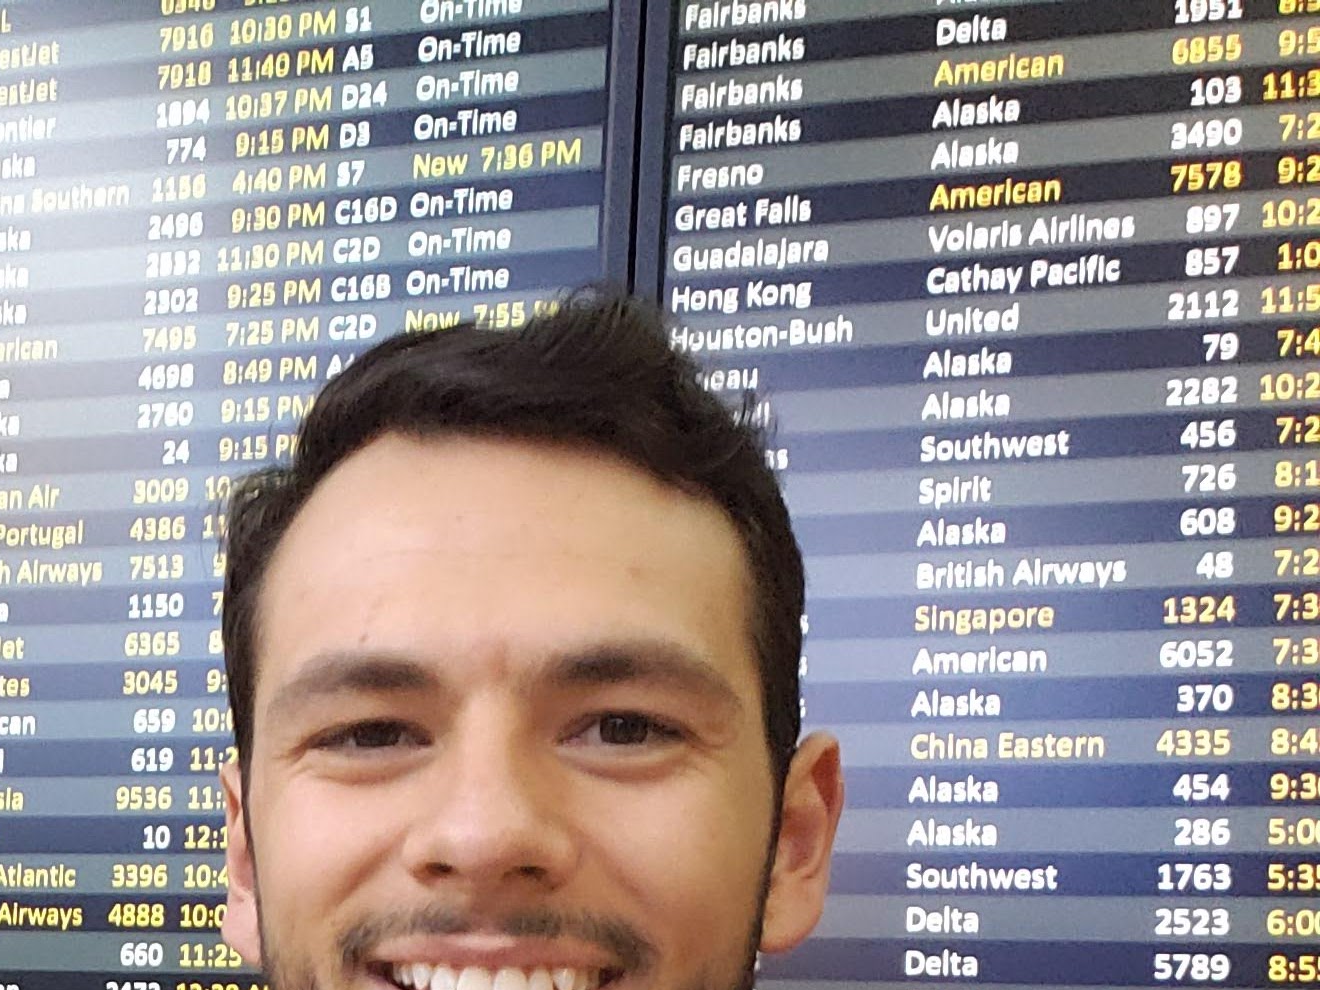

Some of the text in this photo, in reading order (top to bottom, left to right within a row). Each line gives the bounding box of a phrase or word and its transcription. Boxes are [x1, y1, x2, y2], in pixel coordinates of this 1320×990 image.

[297, 48, 335, 76] PM
[418, 31, 522, 63] On-Time
[683, 0, 1244, 71] Fairbanks Delta 1951
[681, 34, 1242, 111] Fairbanks American 6855
[679, 76, 1242, 152] Fairbanks Alaska 103
[289, 163, 327, 191] PM
[414, 154, 468, 179] Now
[541, 138, 582, 168] PM
[677, 119, 1243, 192] Fresno Alaska 3490
[674, 161, 1242, 232] Great Falls American 7578
[672, 204, 1240, 272] Guadalajara Volaris Airlines 897
[671, 246, 1240, 314] Hong Kong Cathay Pacific 857
[670, 290, 1239, 353] Houston-Bush United 2112
[920, 420, 1237, 463] Southwest 456
[918, 464, 1237, 510] Spirit 726
[130, 516, 186, 542] 4386
[916, 552, 1234, 590] British Airways 48
[914, 596, 1236, 636] Singapore 1324
[125, 632, 180, 657] 6365
[912, 640, 1234, 675] American 6052
[123, 670, 178, 695] 3045
[910, 684, 1234, 718] Alaska 370
[134, 709, 176, 734] 659
[131, 748, 174, 772] 619
[910, 729, 1231, 760] China Eastern 4335
[143, 825, 171, 850] 10
[112, 865, 168, 888] 3396
[906, 862, 1232, 891] Southwest 1763
[108, 904, 165, 928] 4888
[905, 906, 1230, 936] Delta 2523
[904, 949, 1231, 981] Delta 5789
